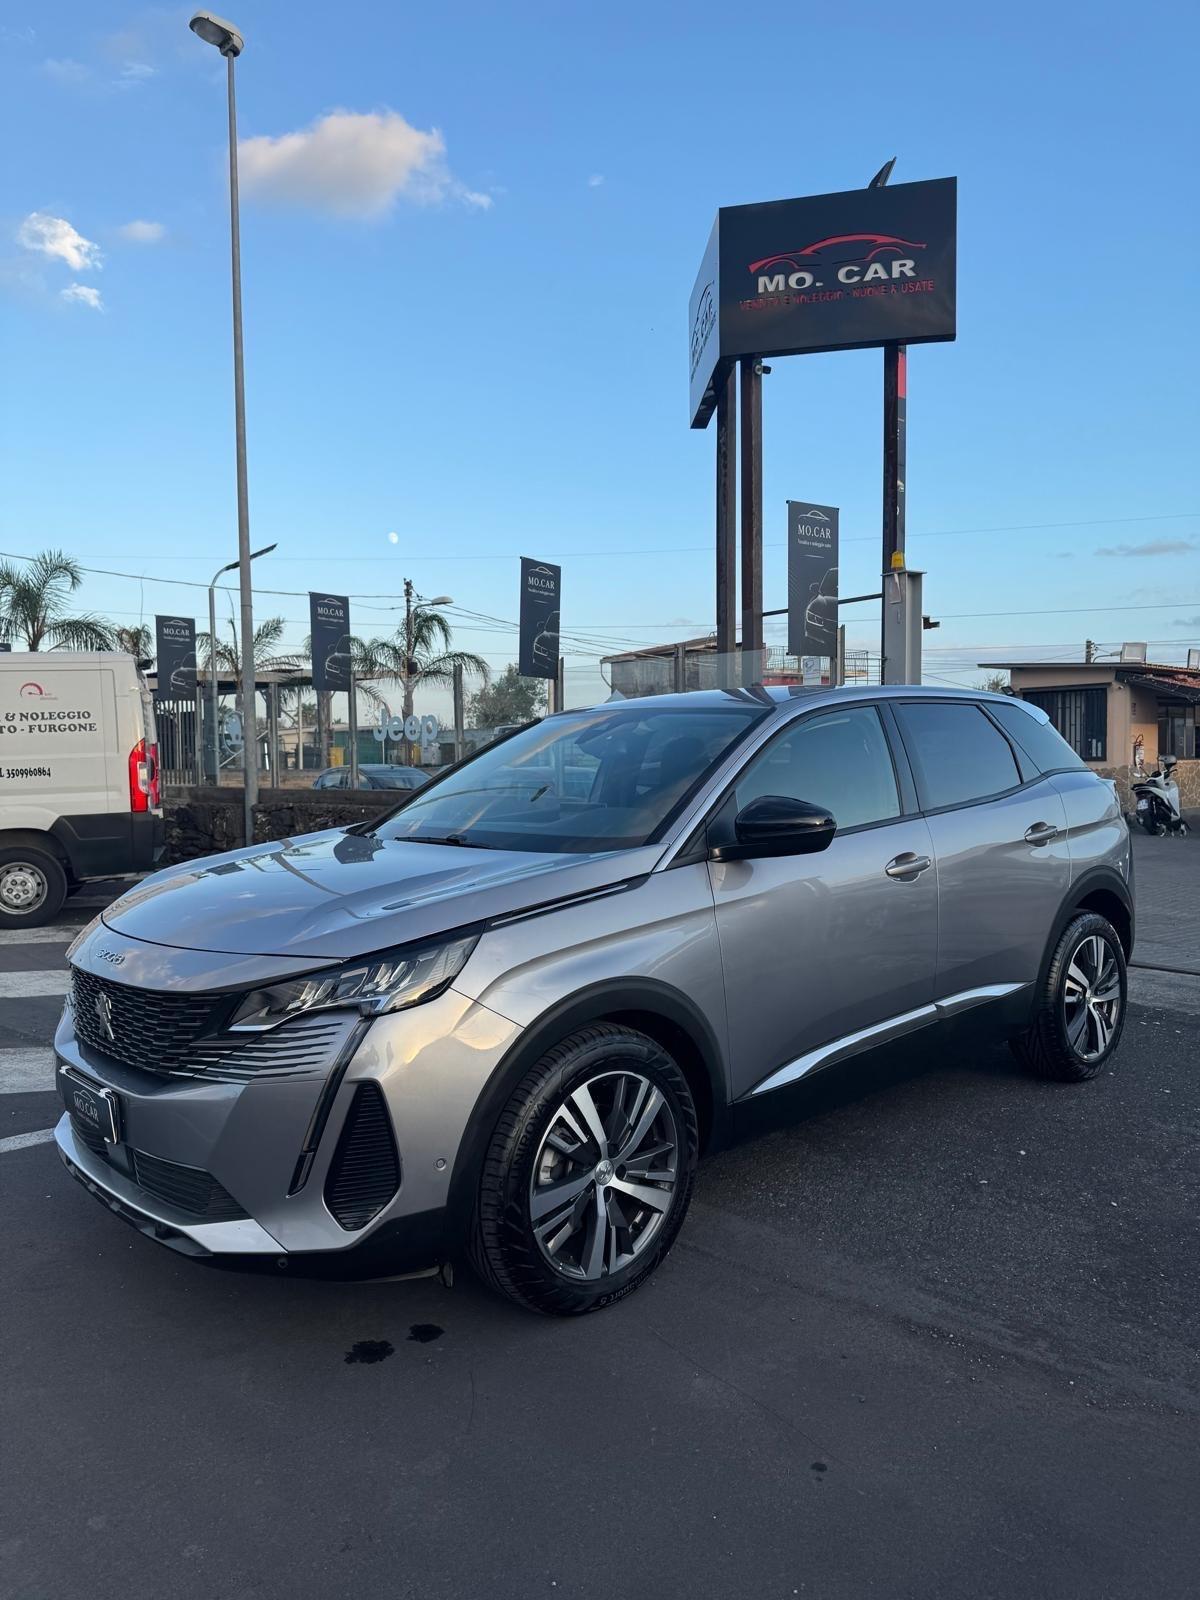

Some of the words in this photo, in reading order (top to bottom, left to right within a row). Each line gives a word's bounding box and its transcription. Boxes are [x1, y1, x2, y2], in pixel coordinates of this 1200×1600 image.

[757, 271, 824, 294] MO.
[837, 259, 917, 284] CAR
[901, 279, 936, 294] USATE
[798, 524, 831, 539] MO.CAR
[527, 575, 555, 590] MO.CAR
[317, 606, 344, 617] MO.CAR
[163, 627, 190, 636] MO.CAR
[5, 712, 16, 722] &
[19, 711, 91, 722] NOLEGGIO
[28, 723, 97, 734] FURGONE
[373, 708, 438, 748] Jeep
[6, 766, 51, 779] 3509960864
